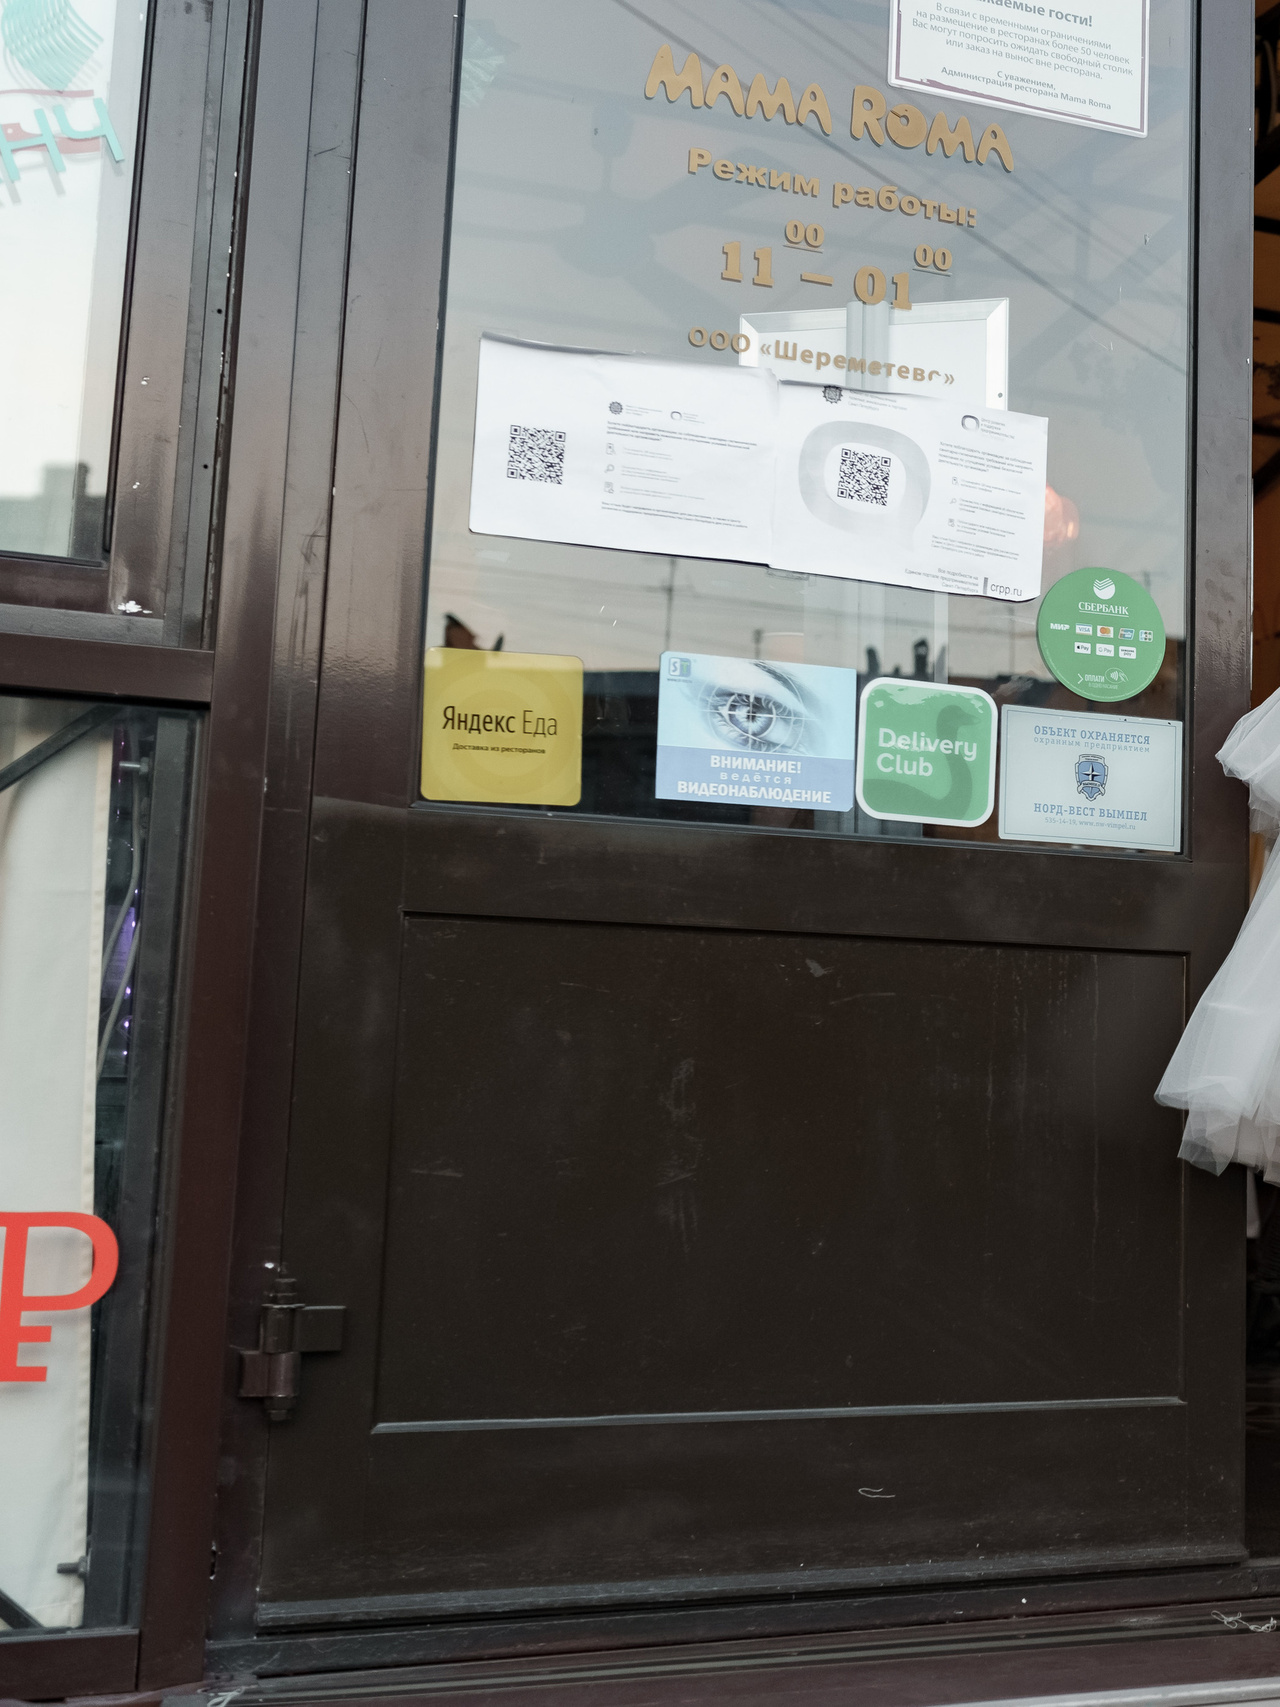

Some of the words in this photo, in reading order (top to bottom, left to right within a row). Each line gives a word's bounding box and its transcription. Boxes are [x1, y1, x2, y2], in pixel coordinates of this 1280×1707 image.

[936, 2, 943, 11] В
[944, 6, 971, 17] связи
[979, 14, 1039, 33] временными
[1041, 28, 1112, 50] ограничениями
[976, 0, 1045, 16] аемые
[1049, 9, 1093, 27] гости!
[912, 18, 928, 29] Вас
[930, 24, 957, 37] могут
[959, 30, 1009, 48] попросить
[1010, 42, 1049, 57] ожидать
[1051, 51, 1101, 69] свободный
[1102, 63, 1133, 76] столик
[916, 10, 928, 18] на
[930, 13, 988, 32] размещение
[997, 28, 1050, 47] ресторанах
[1052, 39, 1079, 53] более
[1081, 46, 1092, 56] 50
[1093, 50, 1130, 64] человек
[946, 38, 963, 48] или
[965, 42, 990, 54] заказ
[992, 48, 1003, 57] на
[1005, 51, 1034, 64] вынос
[1035, 58, 1052, 68] вне
[1054, 62, 1103, 80] ресторана.
[941, 66, 1012, 89] Администрация
[1014, 82, 1059, 99] ресторана
[1060, 92, 1087, 105] Mama
[1088, 98, 1112, 110] Roma
[1004, 73, 1056, 91] уважением,
[644, 43, 832, 136] MAMA
[851, 84, 1014, 172] ROMA
[688, 147, 820, 197] Режим
[832, 181, 978, 228] работы:
[688, 326, 750, 353] ООО
[991, 582, 1023, 598] crpp.ru
[1078, 601, 1129, 615] СБЕРБАНК
[1050, 623, 1070, 631] МИР
[442, 705, 516, 734] Яндекс
[523, 709, 558, 738] Еда
[452, 743, 489, 751] Доставка
[878, 727, 978, 762] Delivery
[1033, 736, 1081, 747] охранным
[1084, 741, 1150, 753] предприятием
[1034, 725, 1077, 739] ОБЪЕКТ
[1080, 730, 1150, 745] ОХРАНЯЕТСЯ
[710, 755, 802, 775] ВНИМАНИЕ!
[876, 753, 934, 777] Club
[677, 780, 832, 804] ВИДЕОНАБЛЮДЕНИЕ
[1034, 803, 1096, 817] НОРД-ВЕСТ
[1099, 808, 1148, 821] ВЫМПЕЛ
